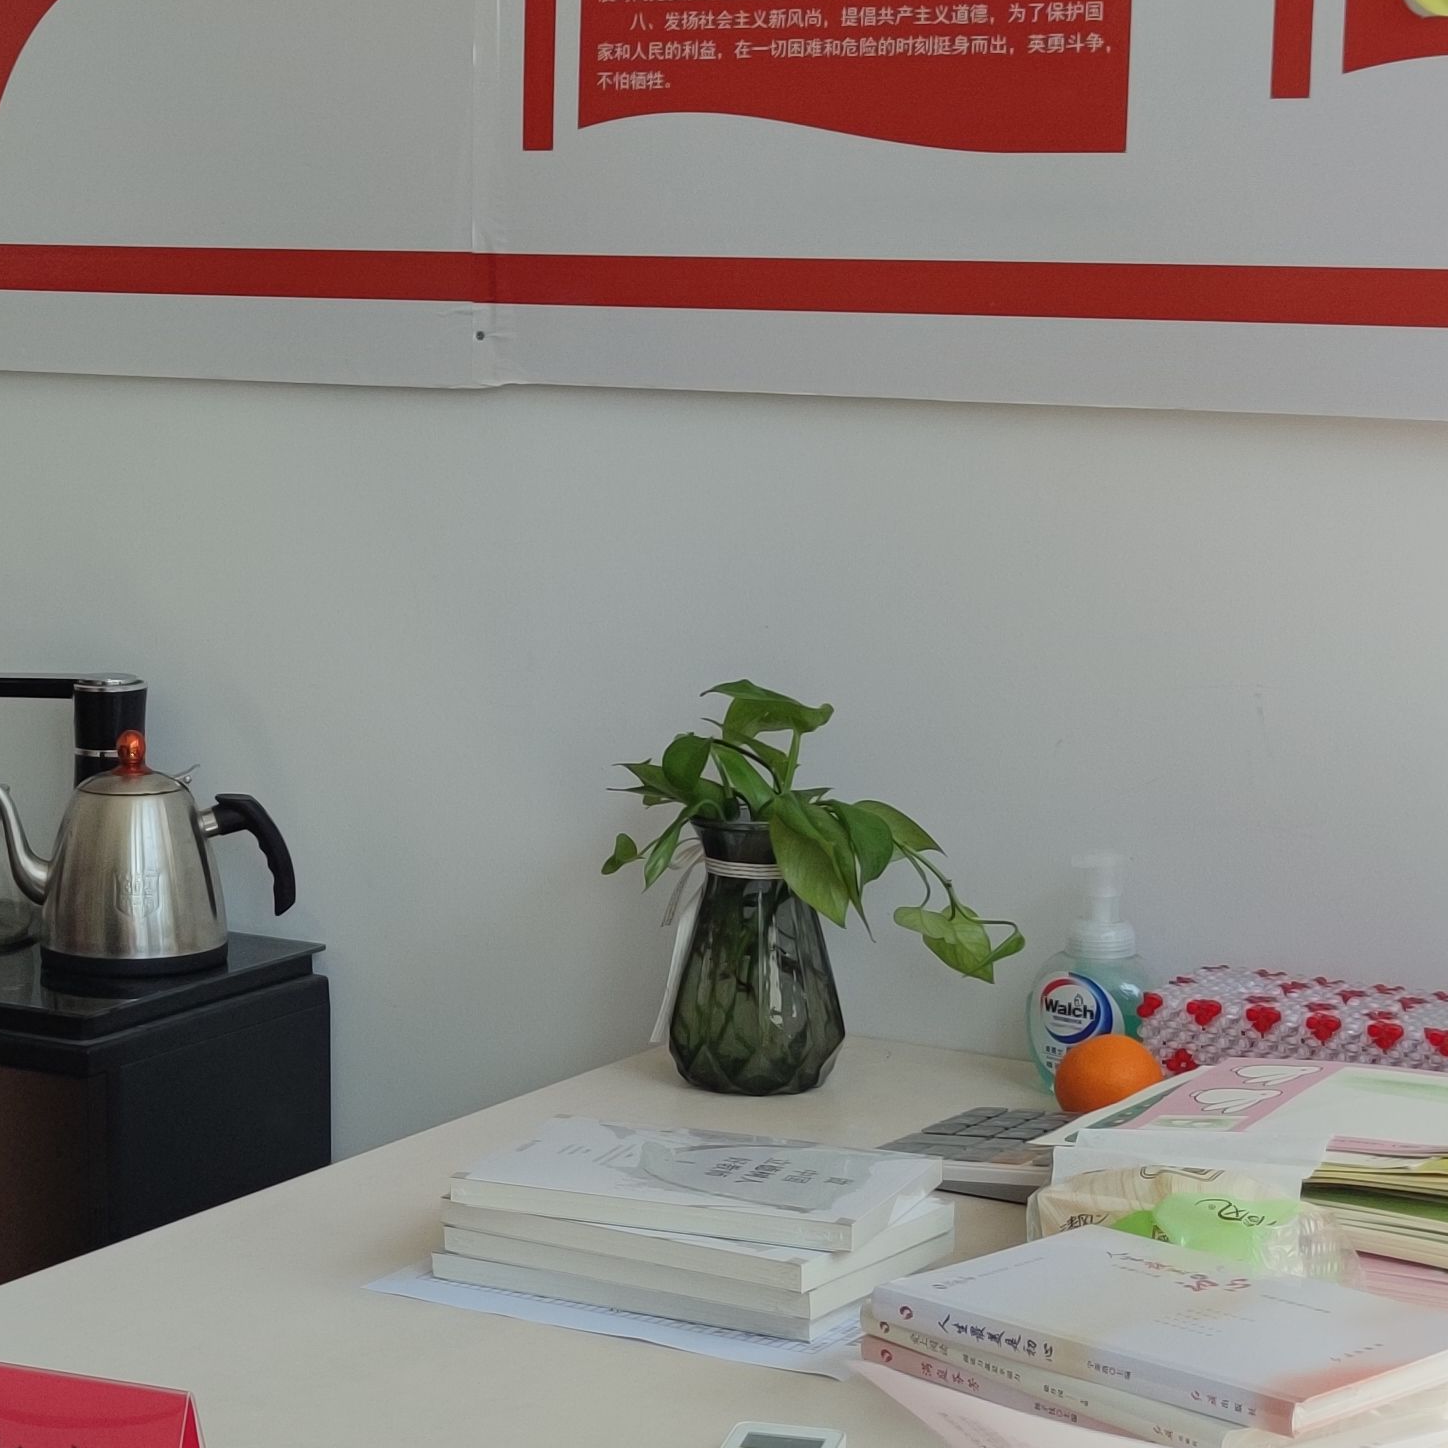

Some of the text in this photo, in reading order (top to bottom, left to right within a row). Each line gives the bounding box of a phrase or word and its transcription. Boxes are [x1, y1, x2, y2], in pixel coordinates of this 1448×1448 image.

[1045, 997, 1094, 1020] Walch
[938, 1314, 1054, 1362] 人生最美是初心
